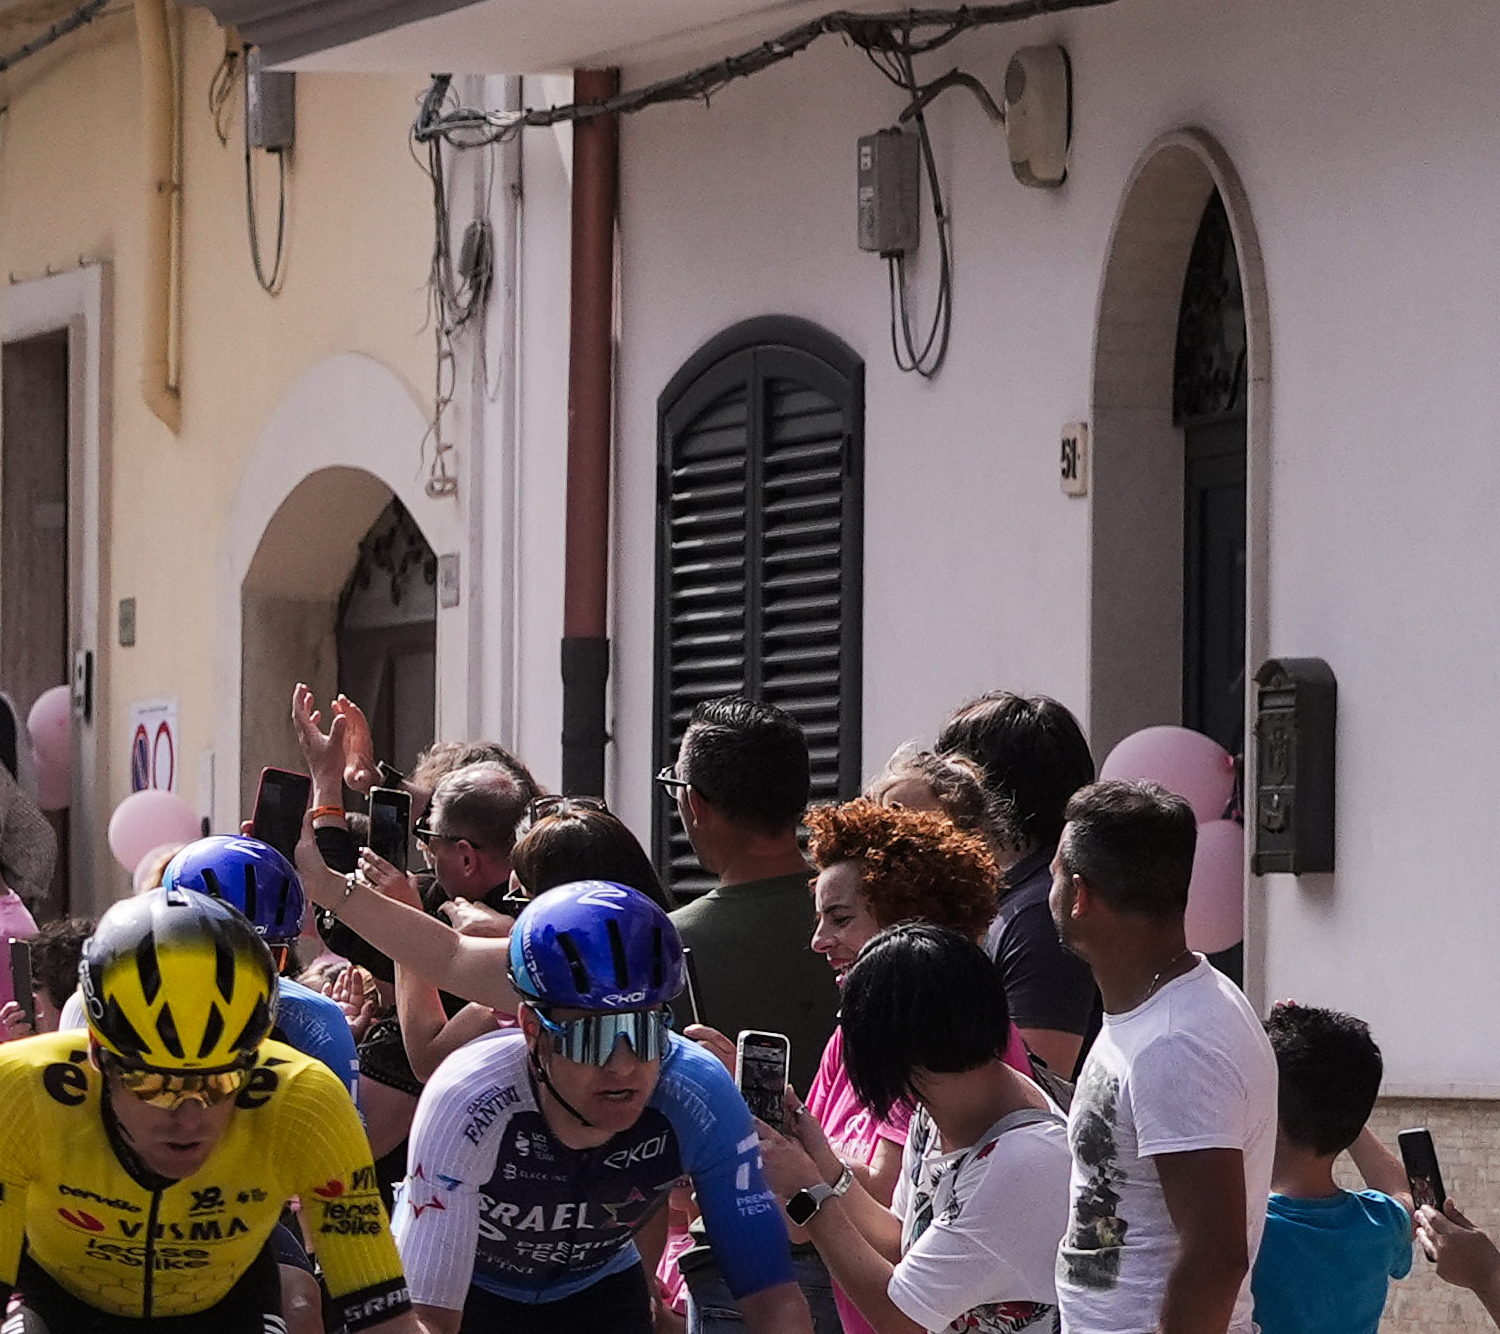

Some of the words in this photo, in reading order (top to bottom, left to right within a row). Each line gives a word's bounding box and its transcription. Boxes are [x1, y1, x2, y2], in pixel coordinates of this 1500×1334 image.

[463, 1087, 521, 1147] FANTINI
[533, 1150, 556, 1162] TEAM
[518, 1170, 550, 1181] BLACK
[551, 1174, 569, 1183] INC
[117, 1217, 251, 1243] VISMA
[88, 1237, 211, 1260] lease
[516, 1247, 587, 1265] TECH
